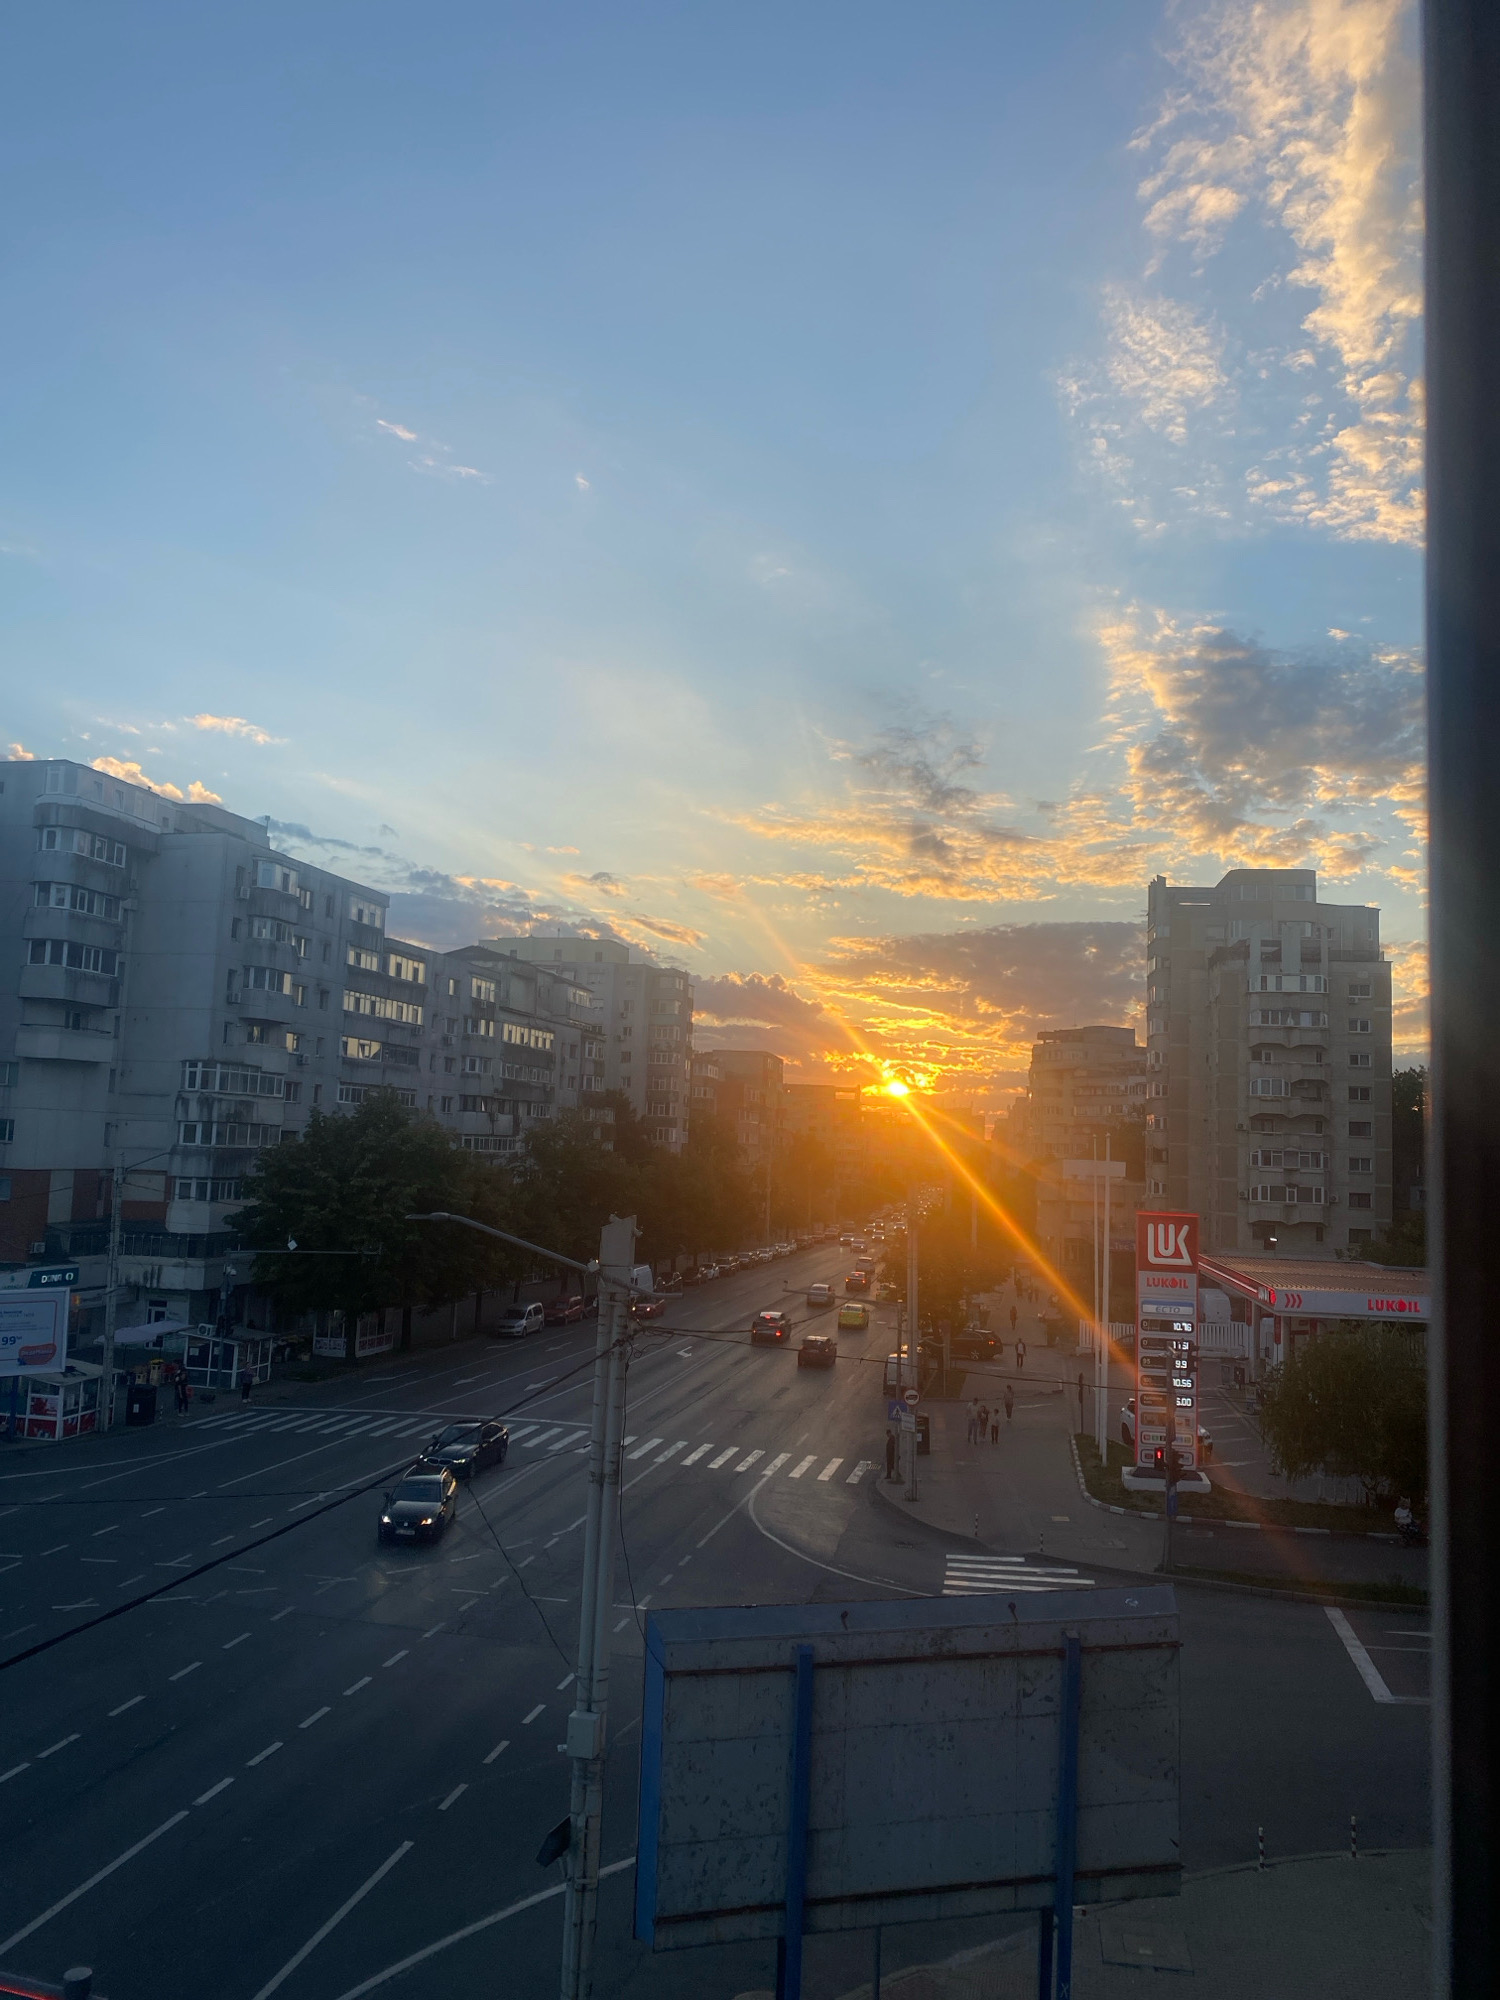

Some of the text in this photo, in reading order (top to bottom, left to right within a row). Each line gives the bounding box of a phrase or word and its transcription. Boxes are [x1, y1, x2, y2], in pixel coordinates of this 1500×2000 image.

[1147, 1223, 1193, 1266] LUK
[1146, 1277, 1189, 1289] LUKOIL
[1155, 1306, 1181, 1314] ECTO
[1367, 1298, 1421, 1313] LUKOIL
